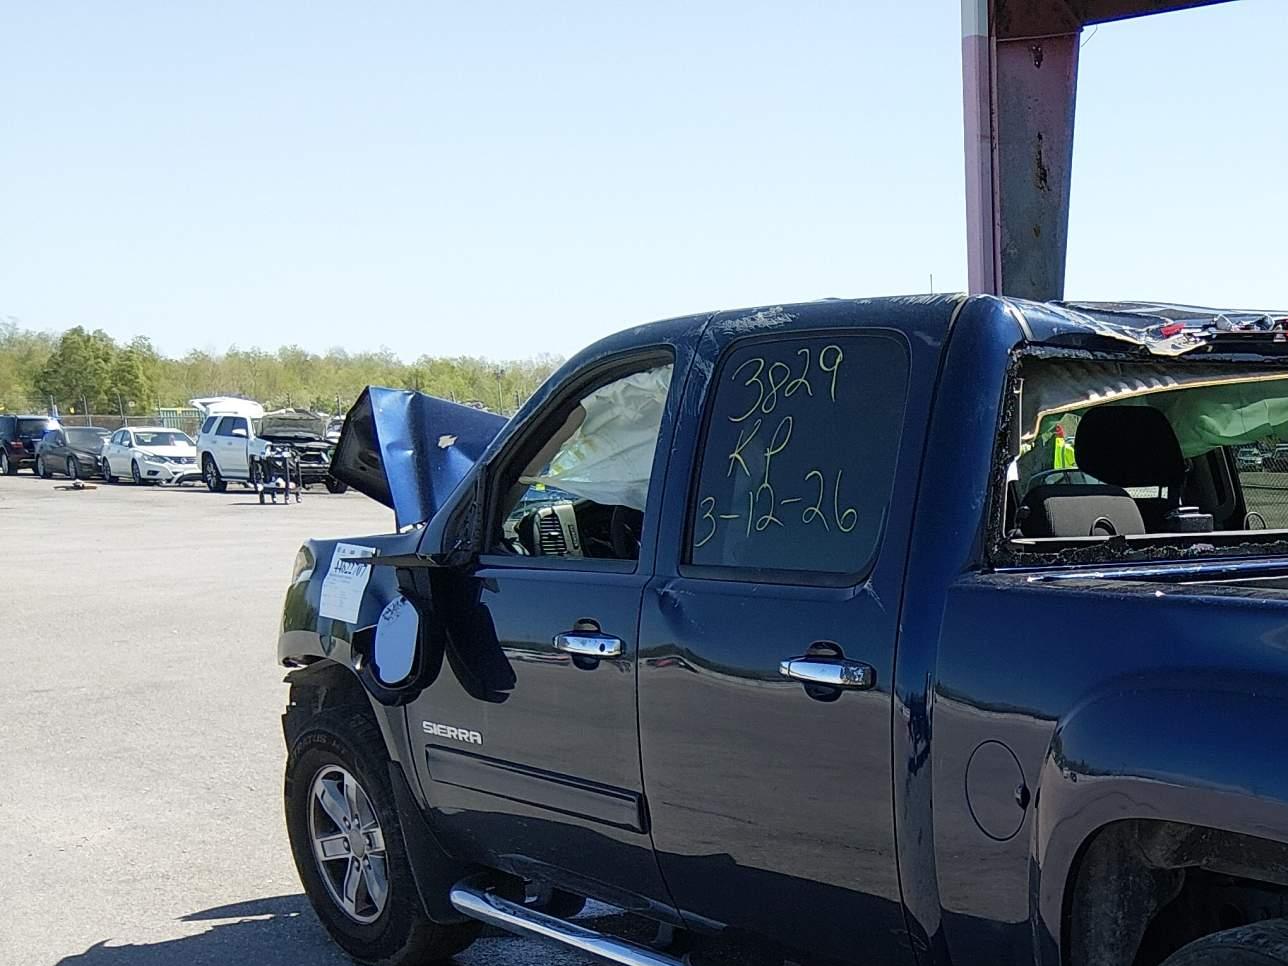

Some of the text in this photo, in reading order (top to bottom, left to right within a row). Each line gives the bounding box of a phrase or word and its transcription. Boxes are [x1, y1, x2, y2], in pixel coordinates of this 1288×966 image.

[727, 344, 843, 423] 3829
[693, 469, 858, 547] 3-12-26
[422, 720, 482, 745] SIERRA
